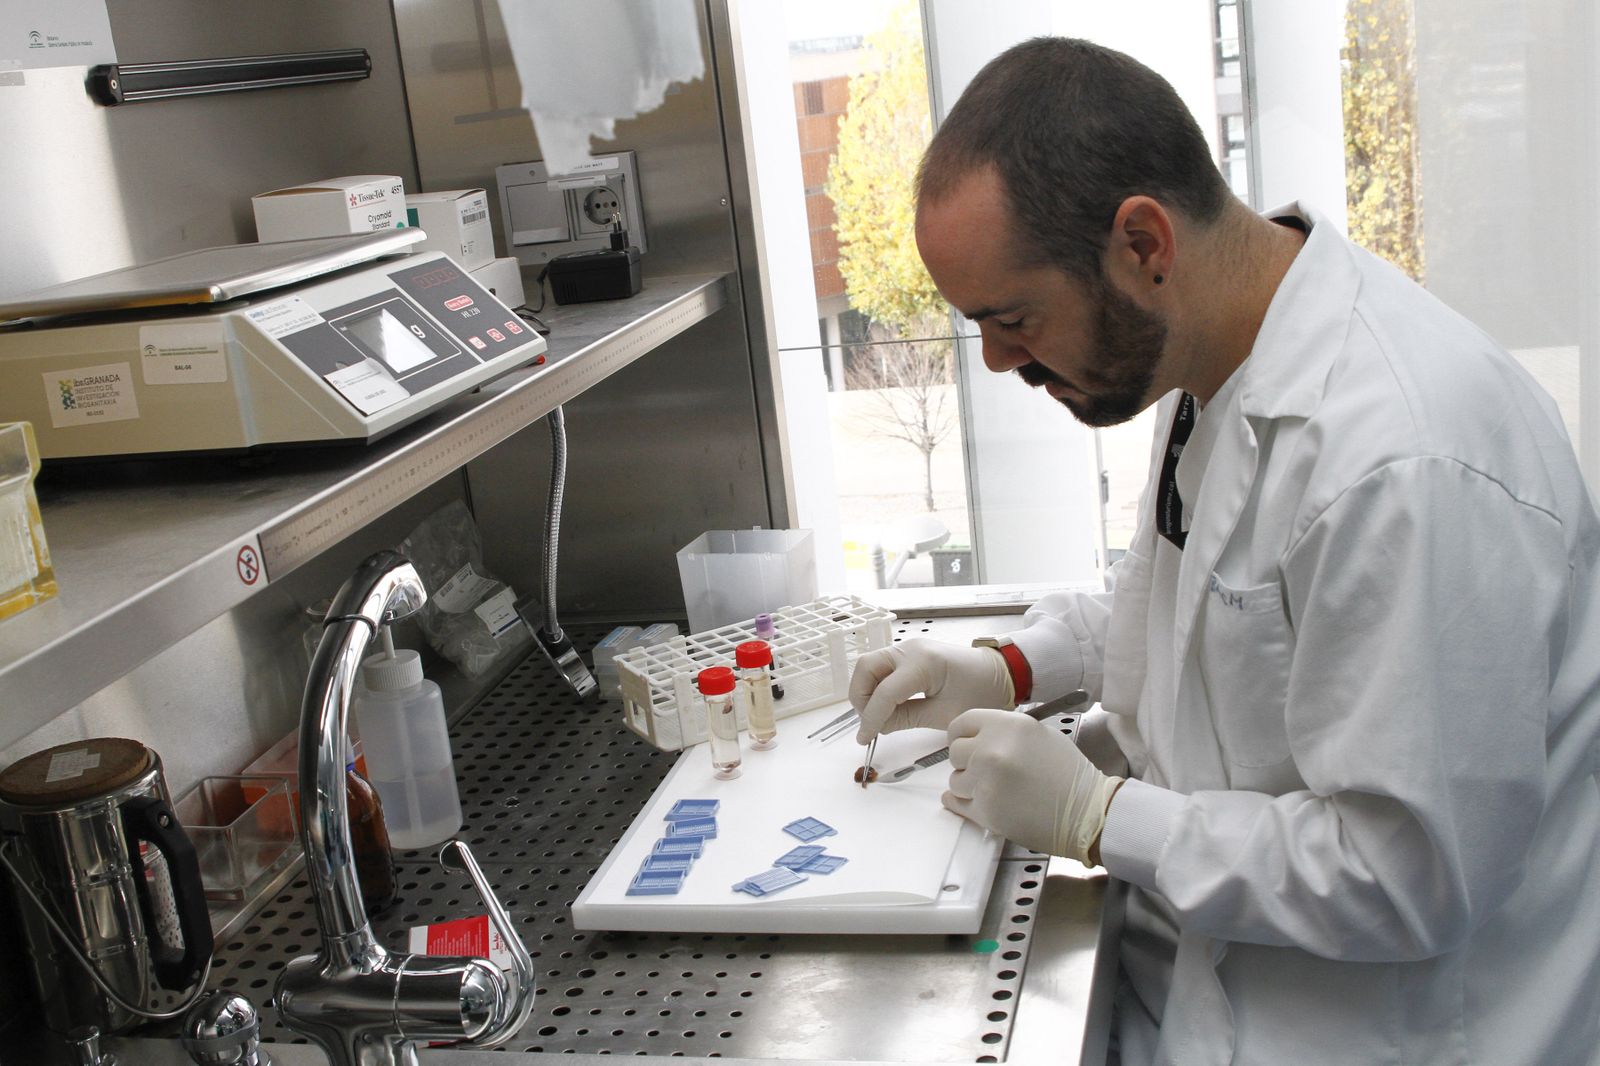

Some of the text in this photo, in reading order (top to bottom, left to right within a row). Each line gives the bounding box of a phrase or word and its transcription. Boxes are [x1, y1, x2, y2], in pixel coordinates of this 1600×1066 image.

[391, 184, 402, 194] 4557
[368, 210, 391, 223] Cryomold
[410, 324, 426, 339] g
